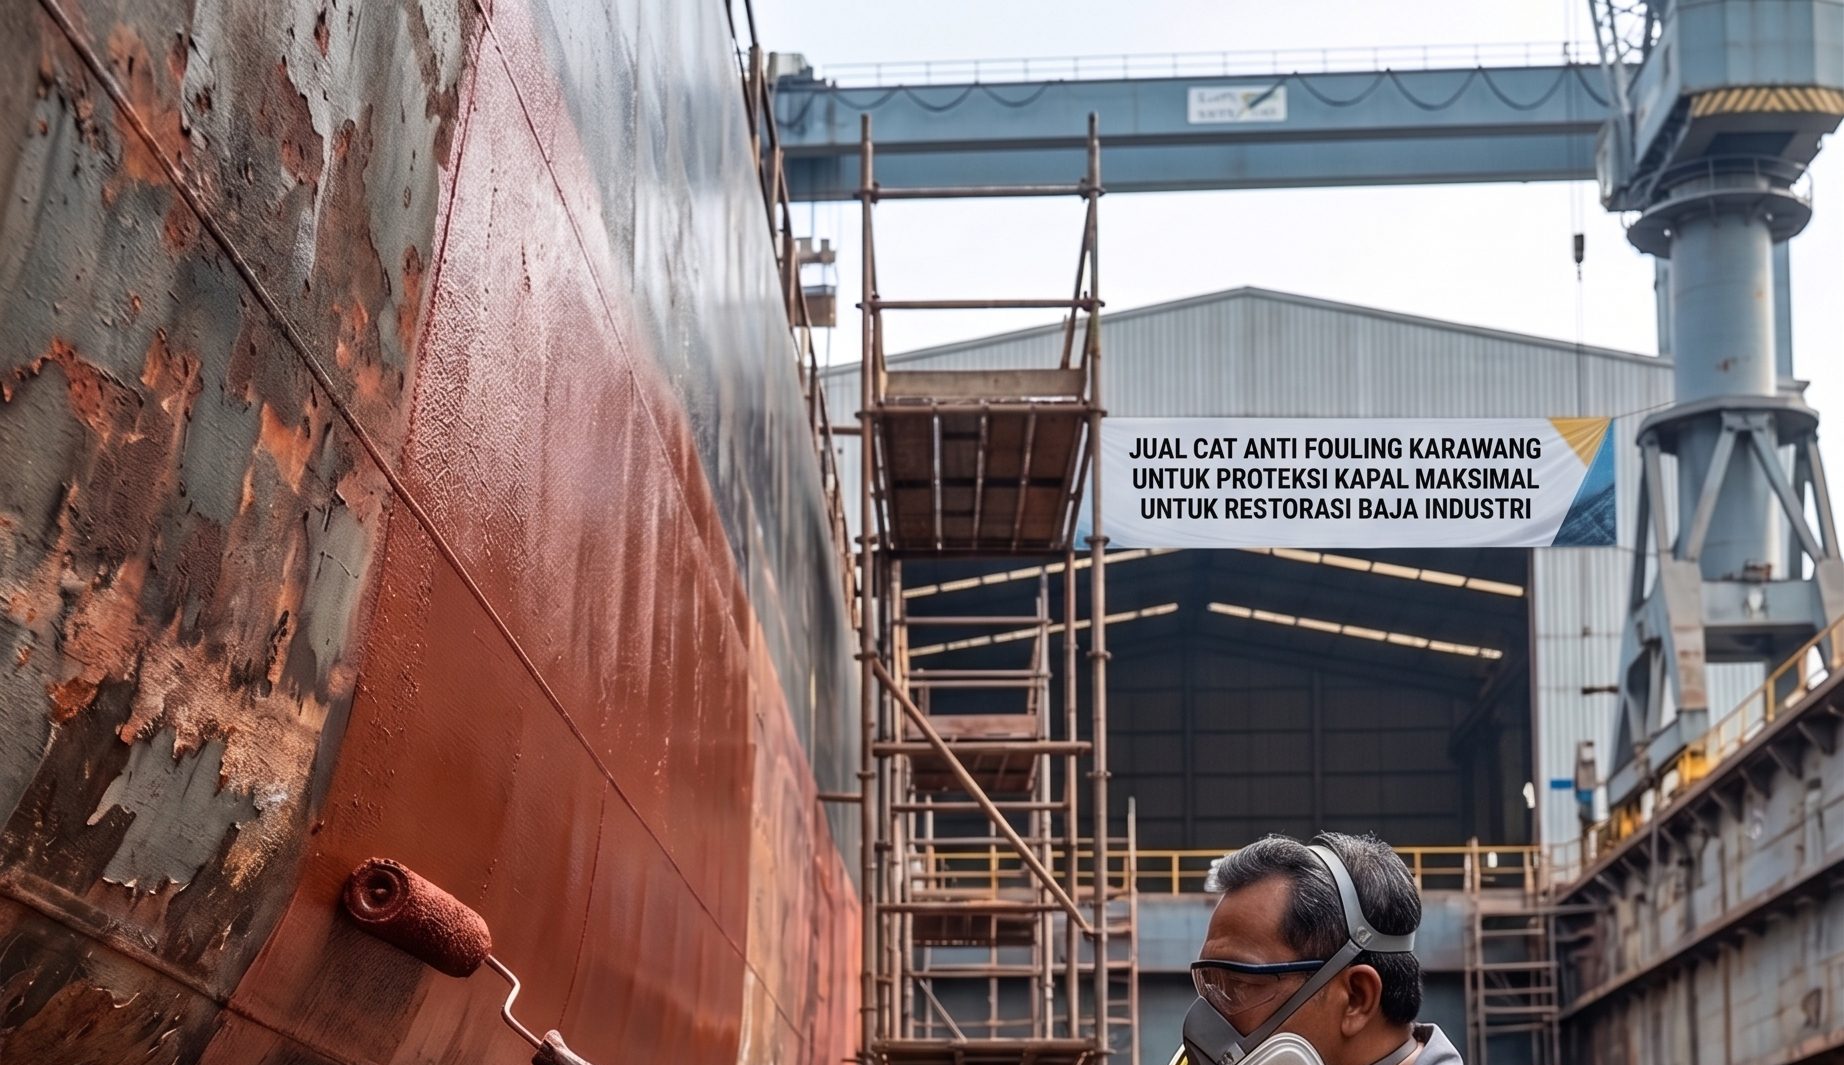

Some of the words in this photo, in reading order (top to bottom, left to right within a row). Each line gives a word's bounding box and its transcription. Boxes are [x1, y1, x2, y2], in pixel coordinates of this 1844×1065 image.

[1129, 438, 1187, 459] JUAL
[1193, 438, 1237, 459] CAT
[1244, 438, 1298, 459] ANTI
[1305, 438, 1402, 459] FOULING
[1409, 438, 1542, 459] KARAWANG
[1132, 468, 1210, 489] UNTUK
[1217, 468, 1328, 489] PROTEKSI
[1335, 468, 1408, 489] KAPAL
[1416, 468, 1540, 489] MAKSIMAL
[1141, 498, 1218, 519] UNTUK
[1225, 498, 1351, 520] RESTORASI
[1359, 498, 1418, 519] BAJA
[1425, 498, 1532, 519] INDUSTRI
